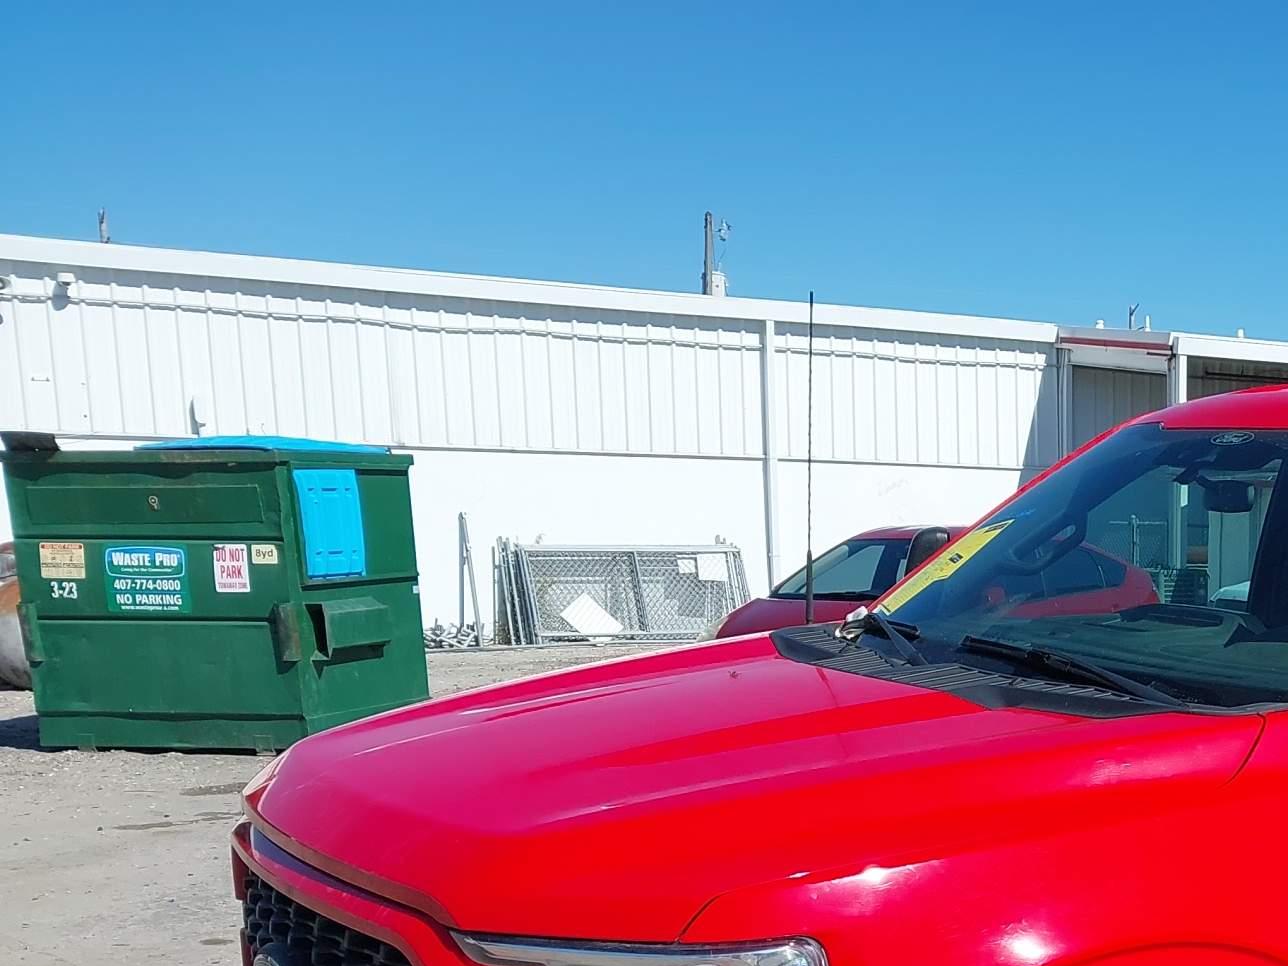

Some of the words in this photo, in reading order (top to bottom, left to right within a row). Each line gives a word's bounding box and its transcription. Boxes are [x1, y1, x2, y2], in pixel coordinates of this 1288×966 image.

[112, 552, 152, 566] WASTE
[215, 548, 226, 562] DO
[229, 548, 245, 562] NOT
[220, 565, 243, 579] PARK
[51, 581, 78, 599] 3-23
[113, 580, 181, 591] 407-774-0800
[115, 593, 133, 604] NO
[135, 594, 182, 605] PARKING
